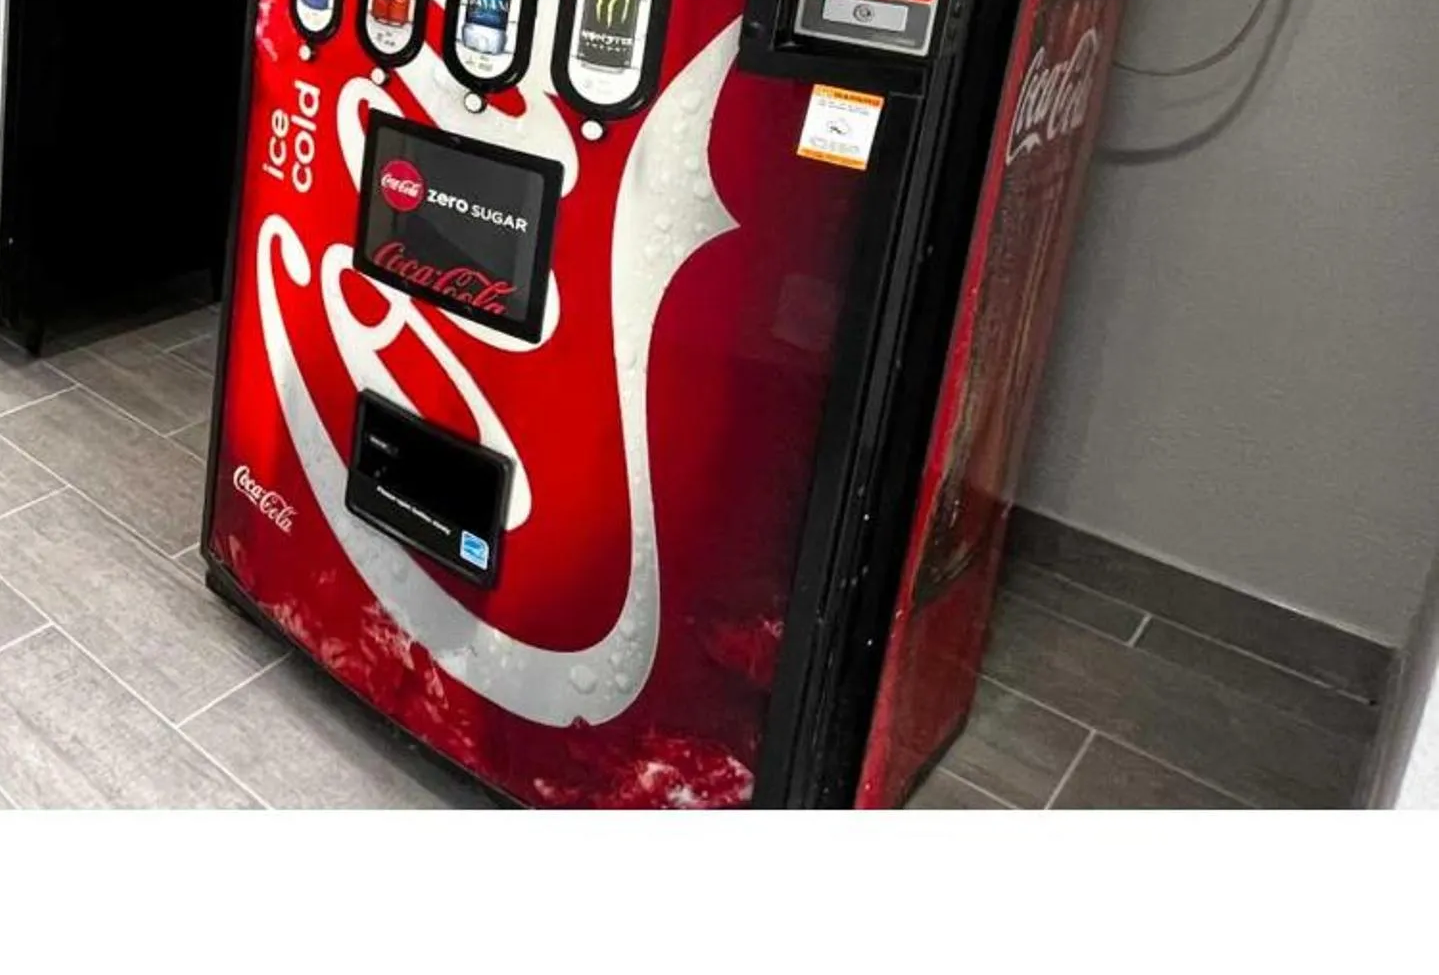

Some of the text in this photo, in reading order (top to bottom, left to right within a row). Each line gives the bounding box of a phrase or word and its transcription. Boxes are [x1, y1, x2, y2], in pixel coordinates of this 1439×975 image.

[262, 108, 291, 181] ice
[291, 79, 321, 193] cold
[427, 188, 529, 234] zero SUGAR
